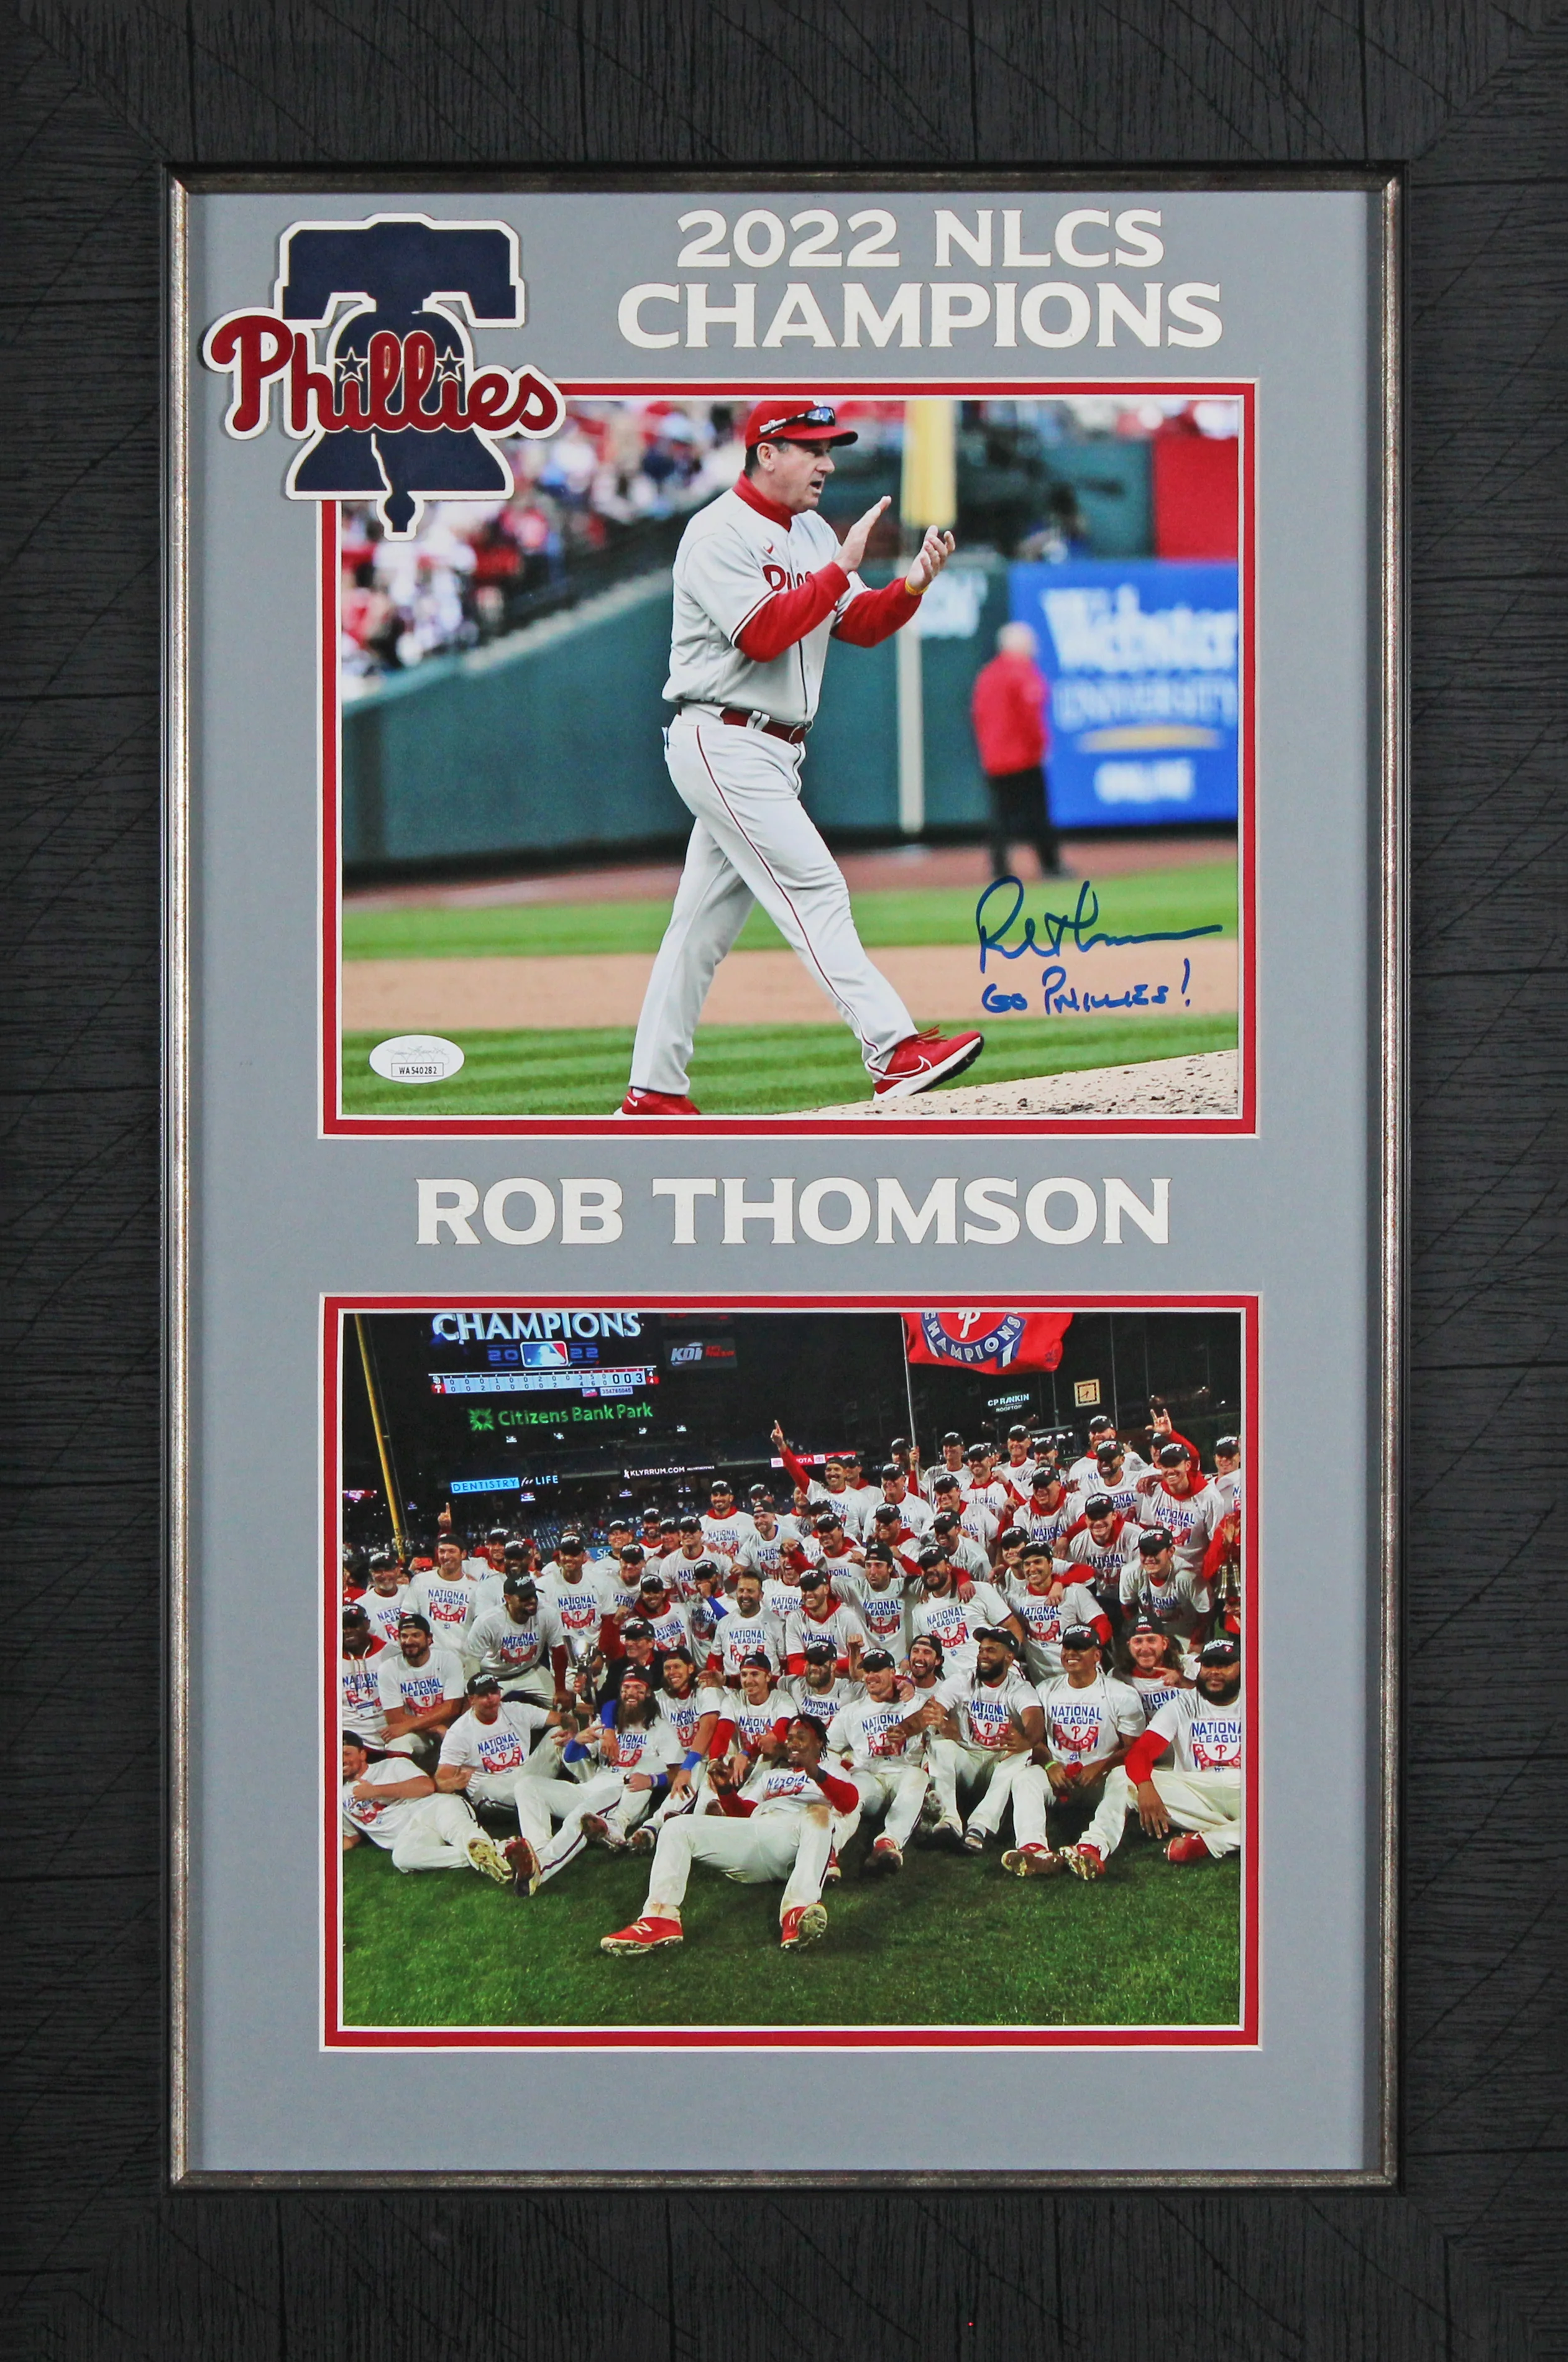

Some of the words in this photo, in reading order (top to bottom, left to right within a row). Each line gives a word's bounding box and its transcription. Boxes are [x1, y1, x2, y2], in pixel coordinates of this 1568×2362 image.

[677, 209, 901, 268] 2022
[934, 209, 1164, 268] NLCS
[618, 282, 1223, 348] CHAMPIONS
[210, 314, 558, 433] Phillies
[415, 1177, 623, 1245] ROB
[653, 1177, 1173, 1245] THOMSON
[432, 1313, 641, 1341] CHAMPIONS
[613, 1374, 620, 1384] 0
[625, 1374, 631, 1383] 0
[636, 1373, 643, 1382] 3
[498, 1409, 569, 1425] Citizens
[572, 1405, 614, 1422] Bank
[617, 1402, 653, 1418] Park
[452, 1479, 516, 1492] DENTISTRY
[535, 1475, 559, 1485] LIFE
[1156, 1507, 1194, 1524] NATIONAL
[708, 1529, 740, 1540] NATIONAL
[428, 1589, 469, 1604] NATIONAL
[558, 1594, 597, 1608] NATIONAL
[927, 1606, 966, 1627] NATIONAL
[1020, 1605, 1061, 1616] NATIONAL
[933, 1617, 961, 1629] LEAGUE
[729, 1629, 766, 1640] NATIONAL
[400, 1678, 443, 1694] NATIONAL
[1052, 1706, 1103, 1721] NATIONAL
[1058, 1716, 1094, 1725] LEAGUE
[1191, 1722, 1241, 1737] NATIONA
[477, 1732, 520, 1754] NATIONAL
[1199, 1734, 1241, 1744] LEAGU
